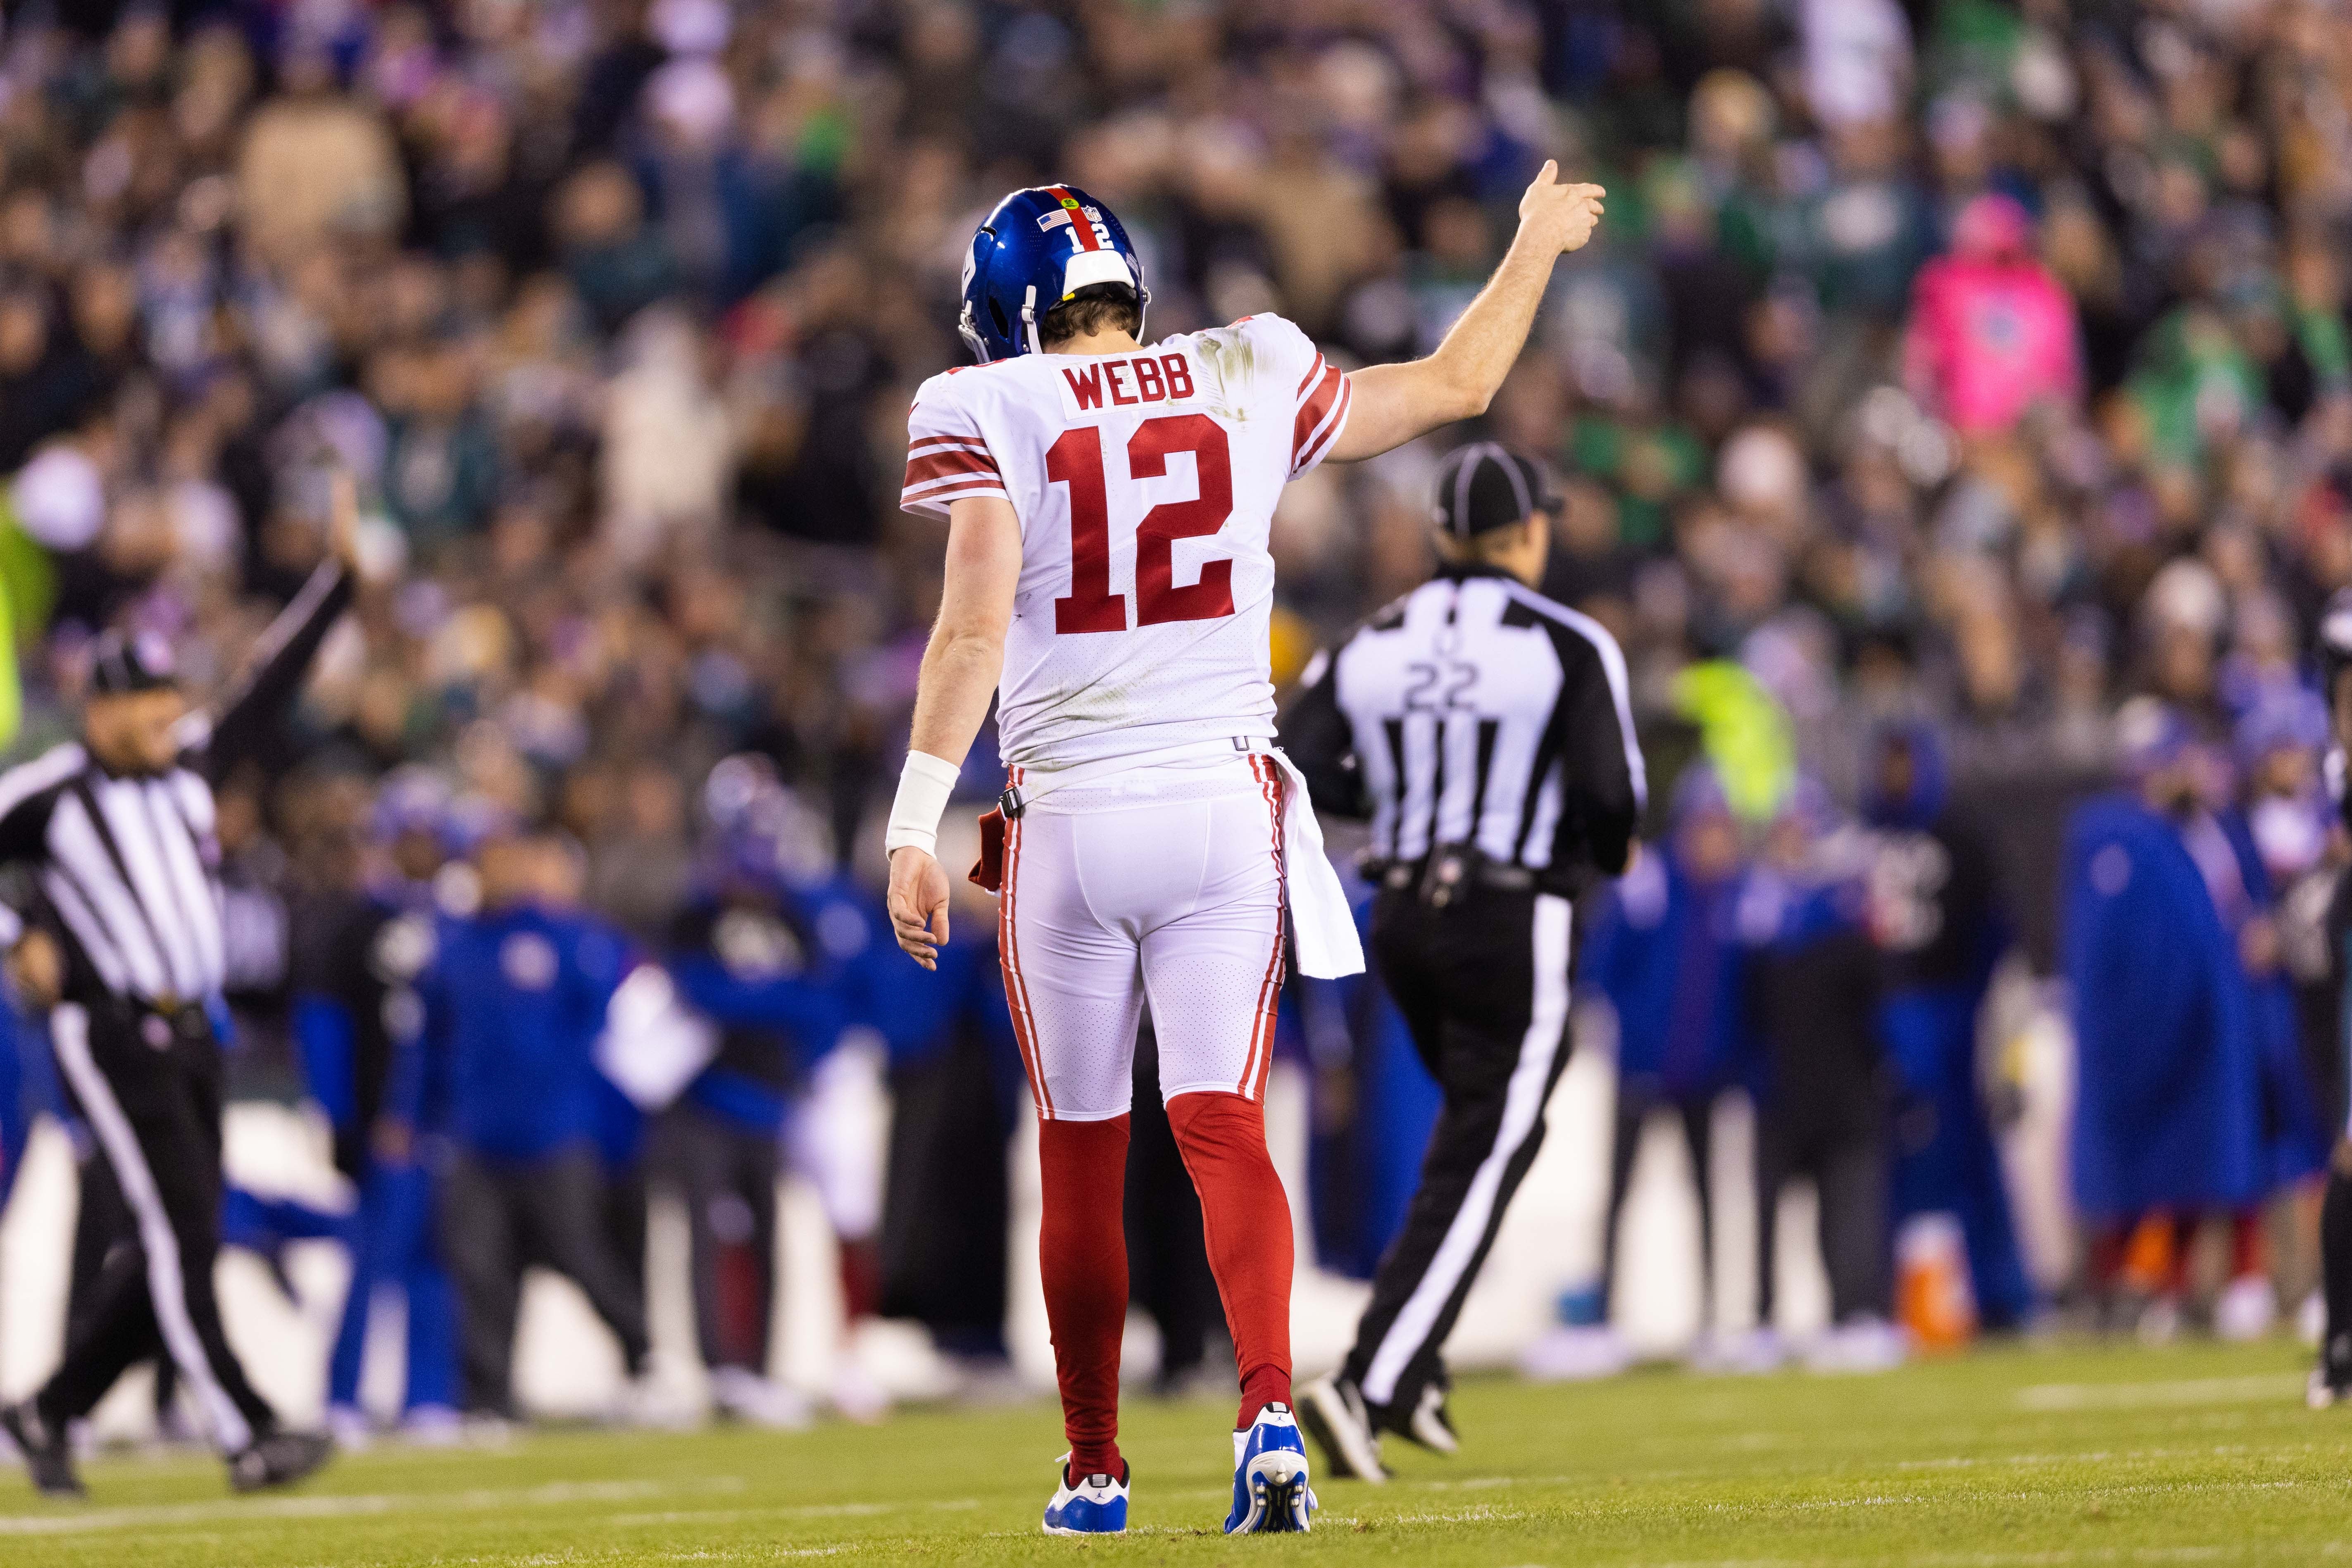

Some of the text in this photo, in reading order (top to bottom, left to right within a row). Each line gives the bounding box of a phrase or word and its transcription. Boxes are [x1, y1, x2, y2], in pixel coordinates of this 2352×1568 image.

[1065, 223, 1114, 254] 12
[1062, 353, 1195, 410] WEBB
[1045, 413, 1236, 634] 12
[1404, 662, 1479, 712] 22
